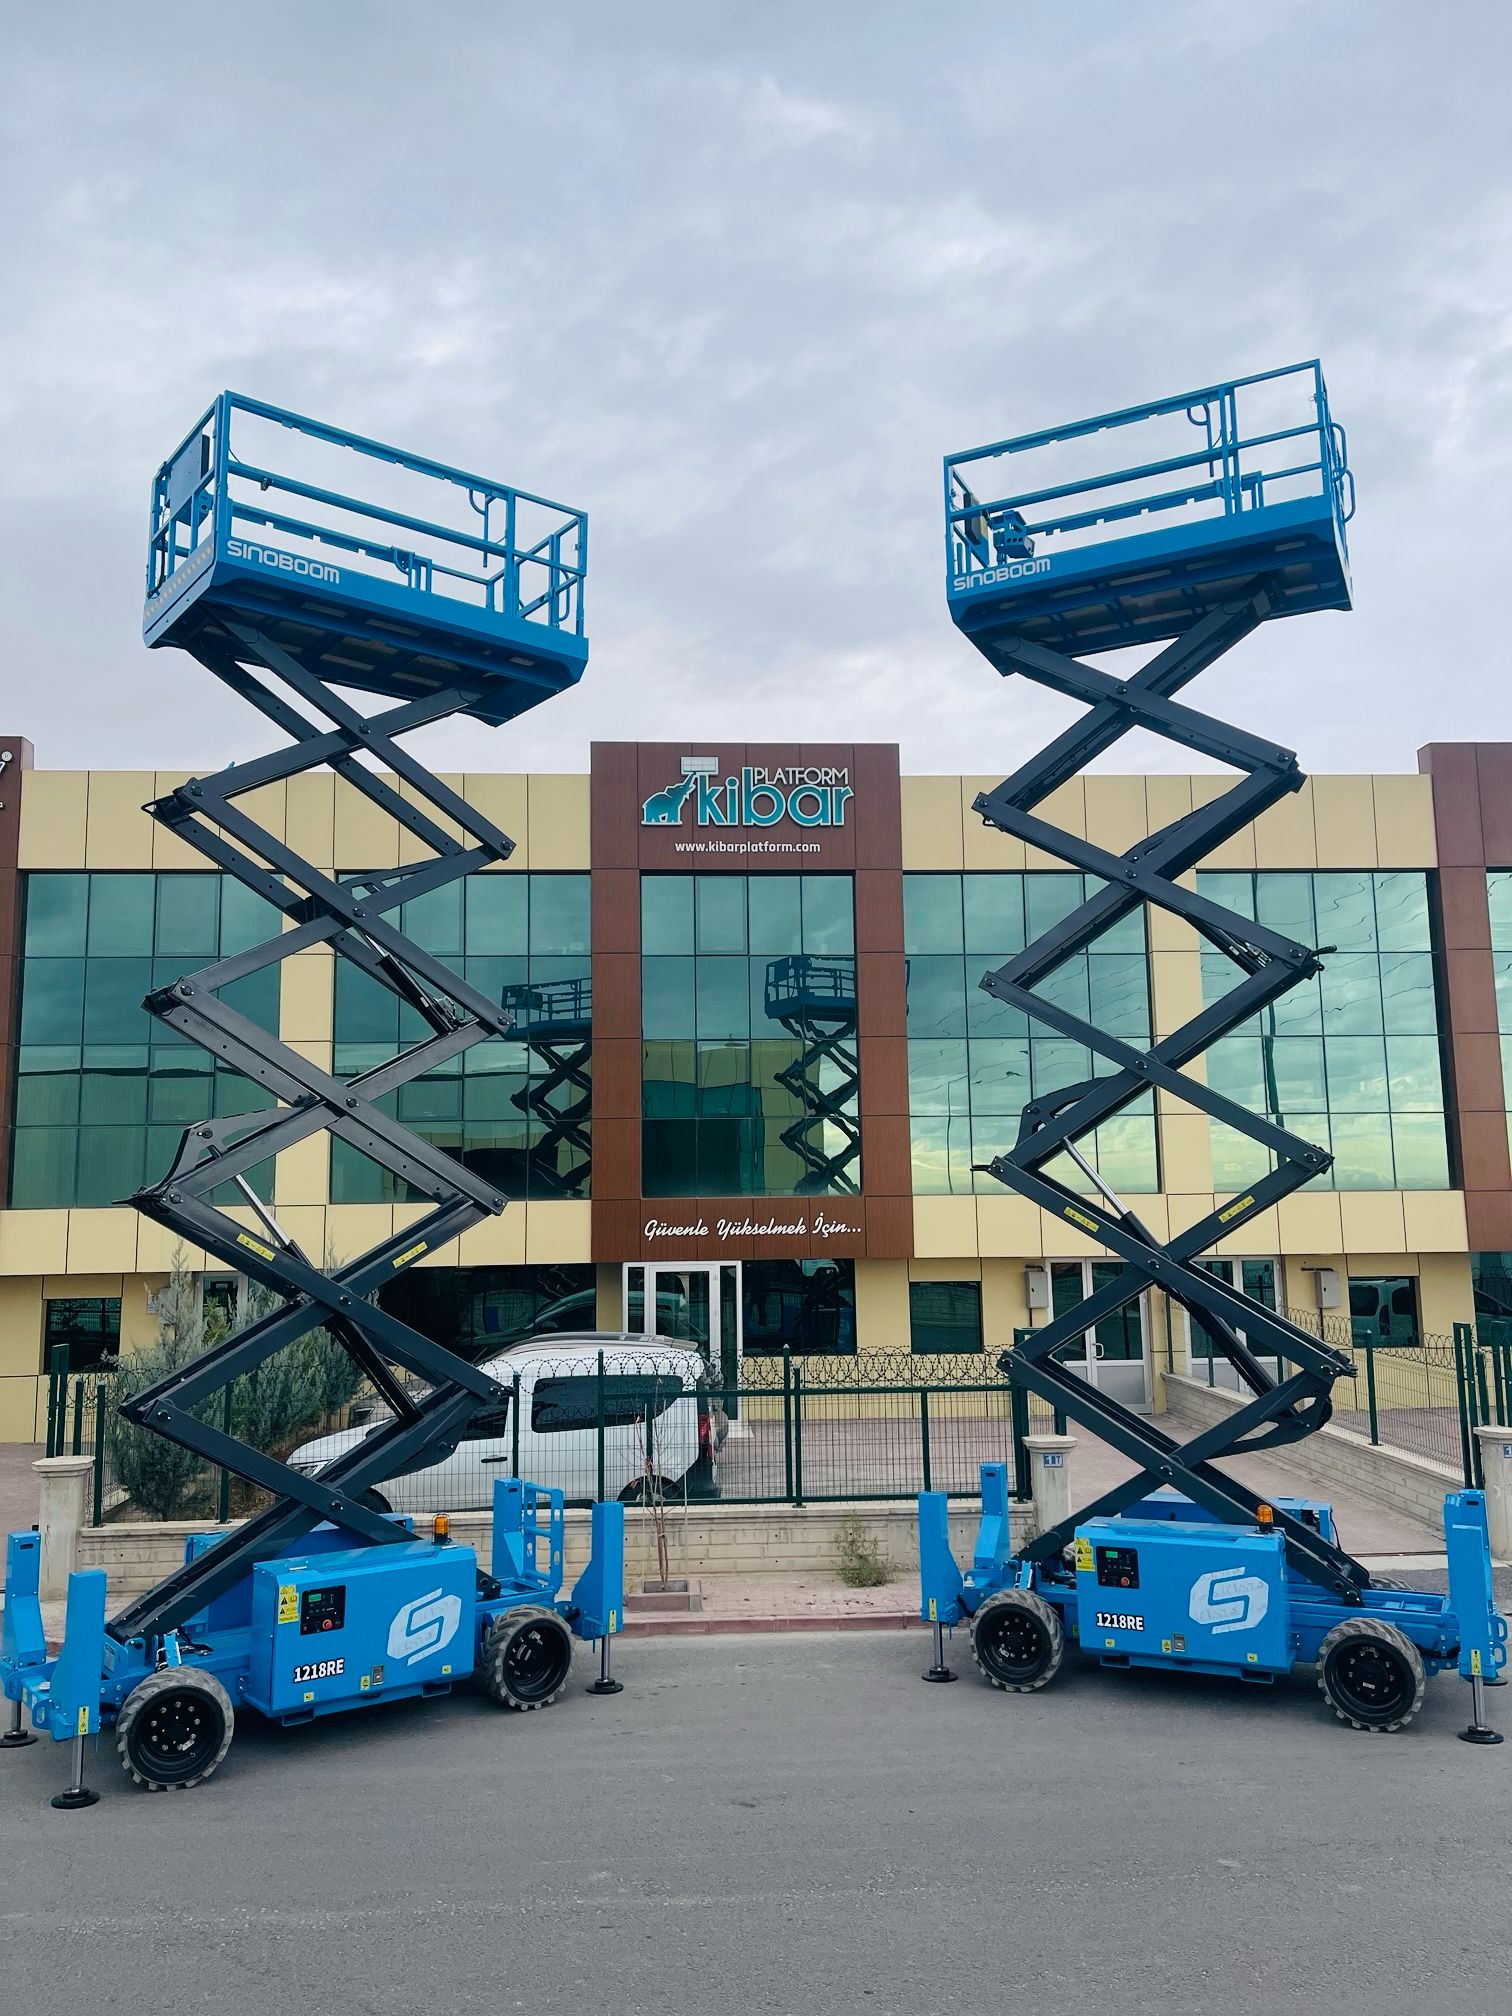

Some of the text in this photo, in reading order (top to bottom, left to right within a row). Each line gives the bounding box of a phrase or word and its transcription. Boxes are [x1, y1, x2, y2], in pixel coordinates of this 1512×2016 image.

[227, 539, 340, 584] SINOBOOM
[953, 558, 1051, 592] SINOBOOM
[754, 767, 849, 785] PLATFORM
[697, 767, 854, 827] kibar
[675, 841, 821, 855] www.kibarplatform.com
[644, 1212, 862, 1241] Güvenle Yükselmek İçin...
[1096, 1612, 1144, 1631] 1218RE
[294, 1658, 345, 1683] 1218RE
